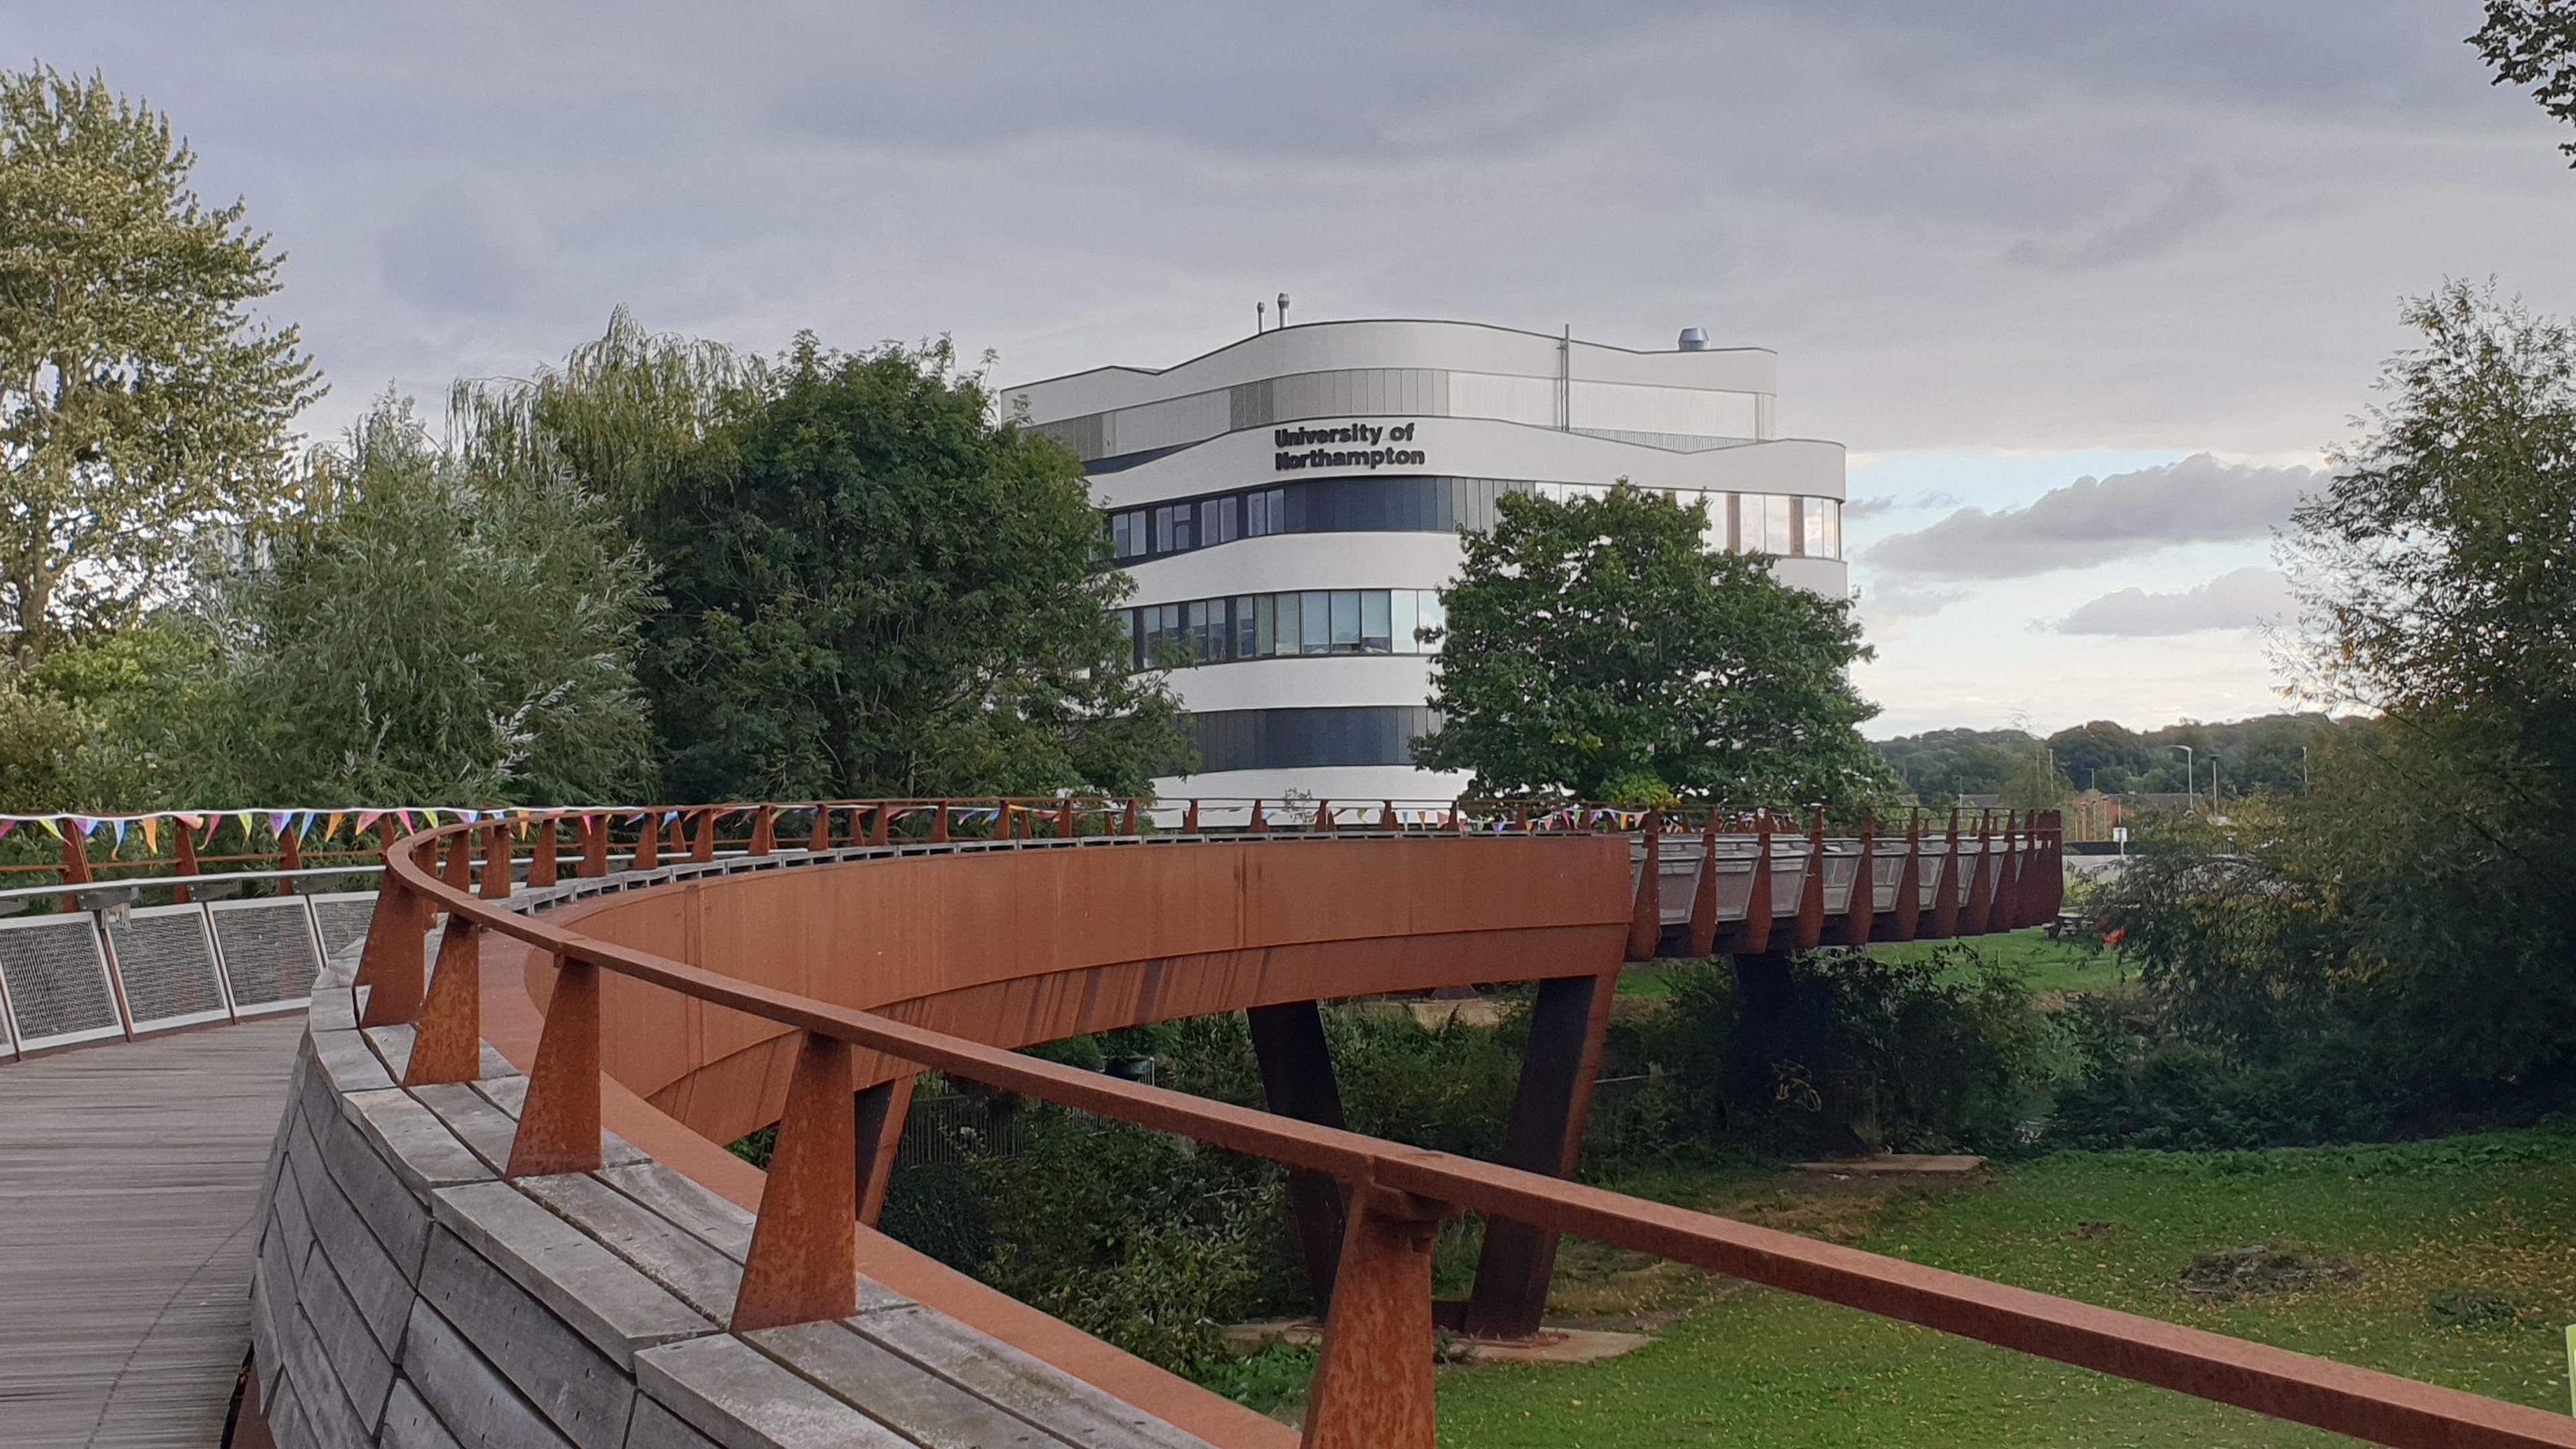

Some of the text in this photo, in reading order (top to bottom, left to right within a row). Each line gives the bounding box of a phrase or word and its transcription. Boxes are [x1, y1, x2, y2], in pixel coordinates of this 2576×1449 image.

[1275, 423, 1415, 447] University of
[1275, 447, 1425, 470] Northampton
